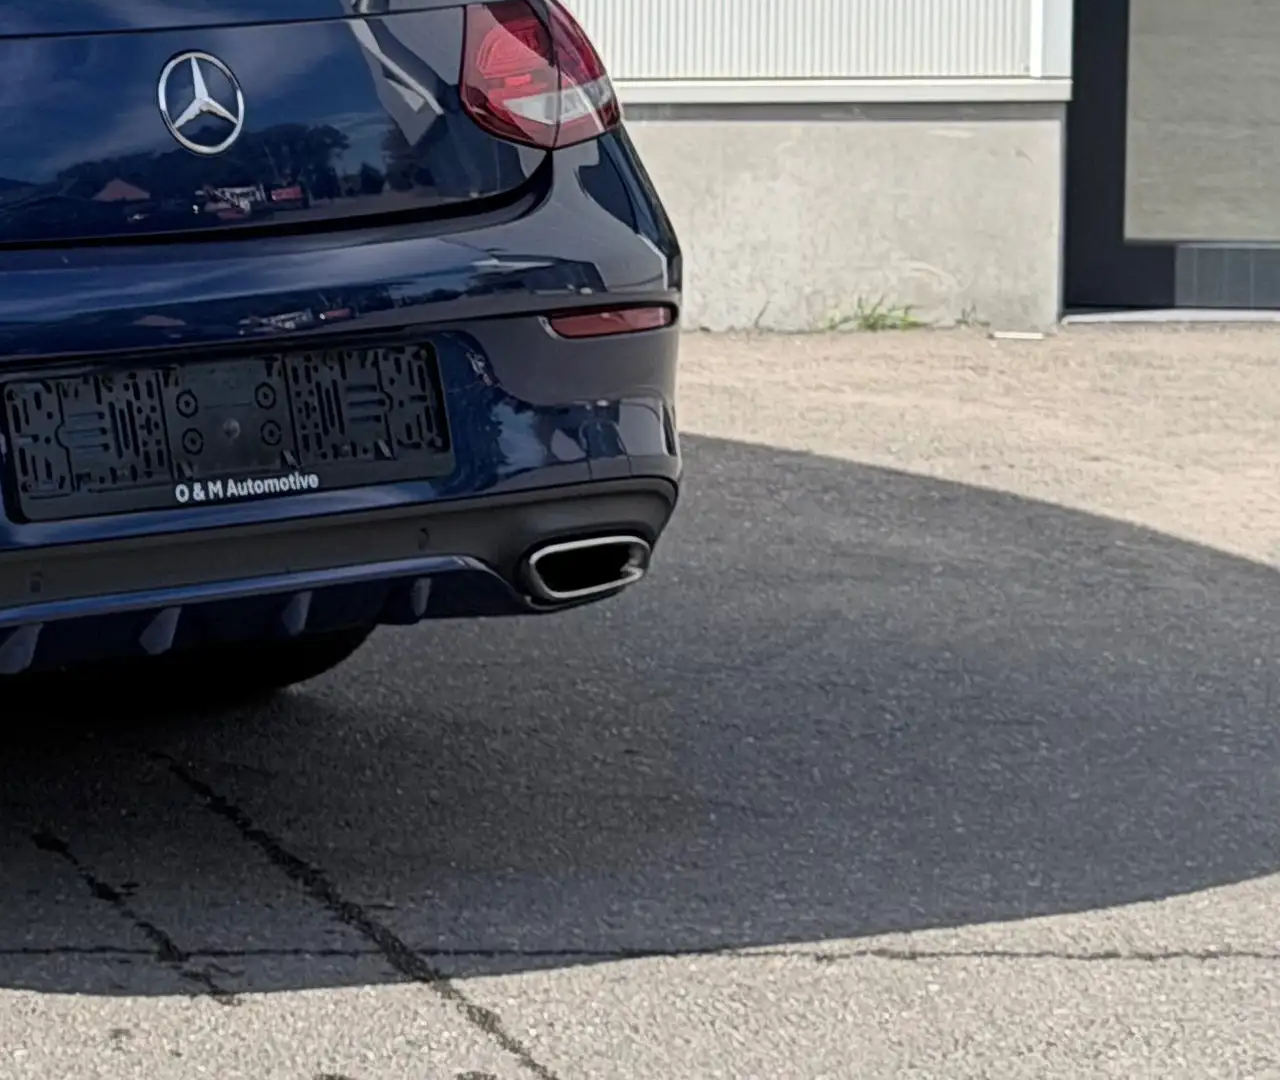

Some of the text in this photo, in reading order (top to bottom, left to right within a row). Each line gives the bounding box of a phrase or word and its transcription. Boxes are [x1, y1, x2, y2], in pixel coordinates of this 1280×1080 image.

[175, 471, 319, 503] O & M Automotive
